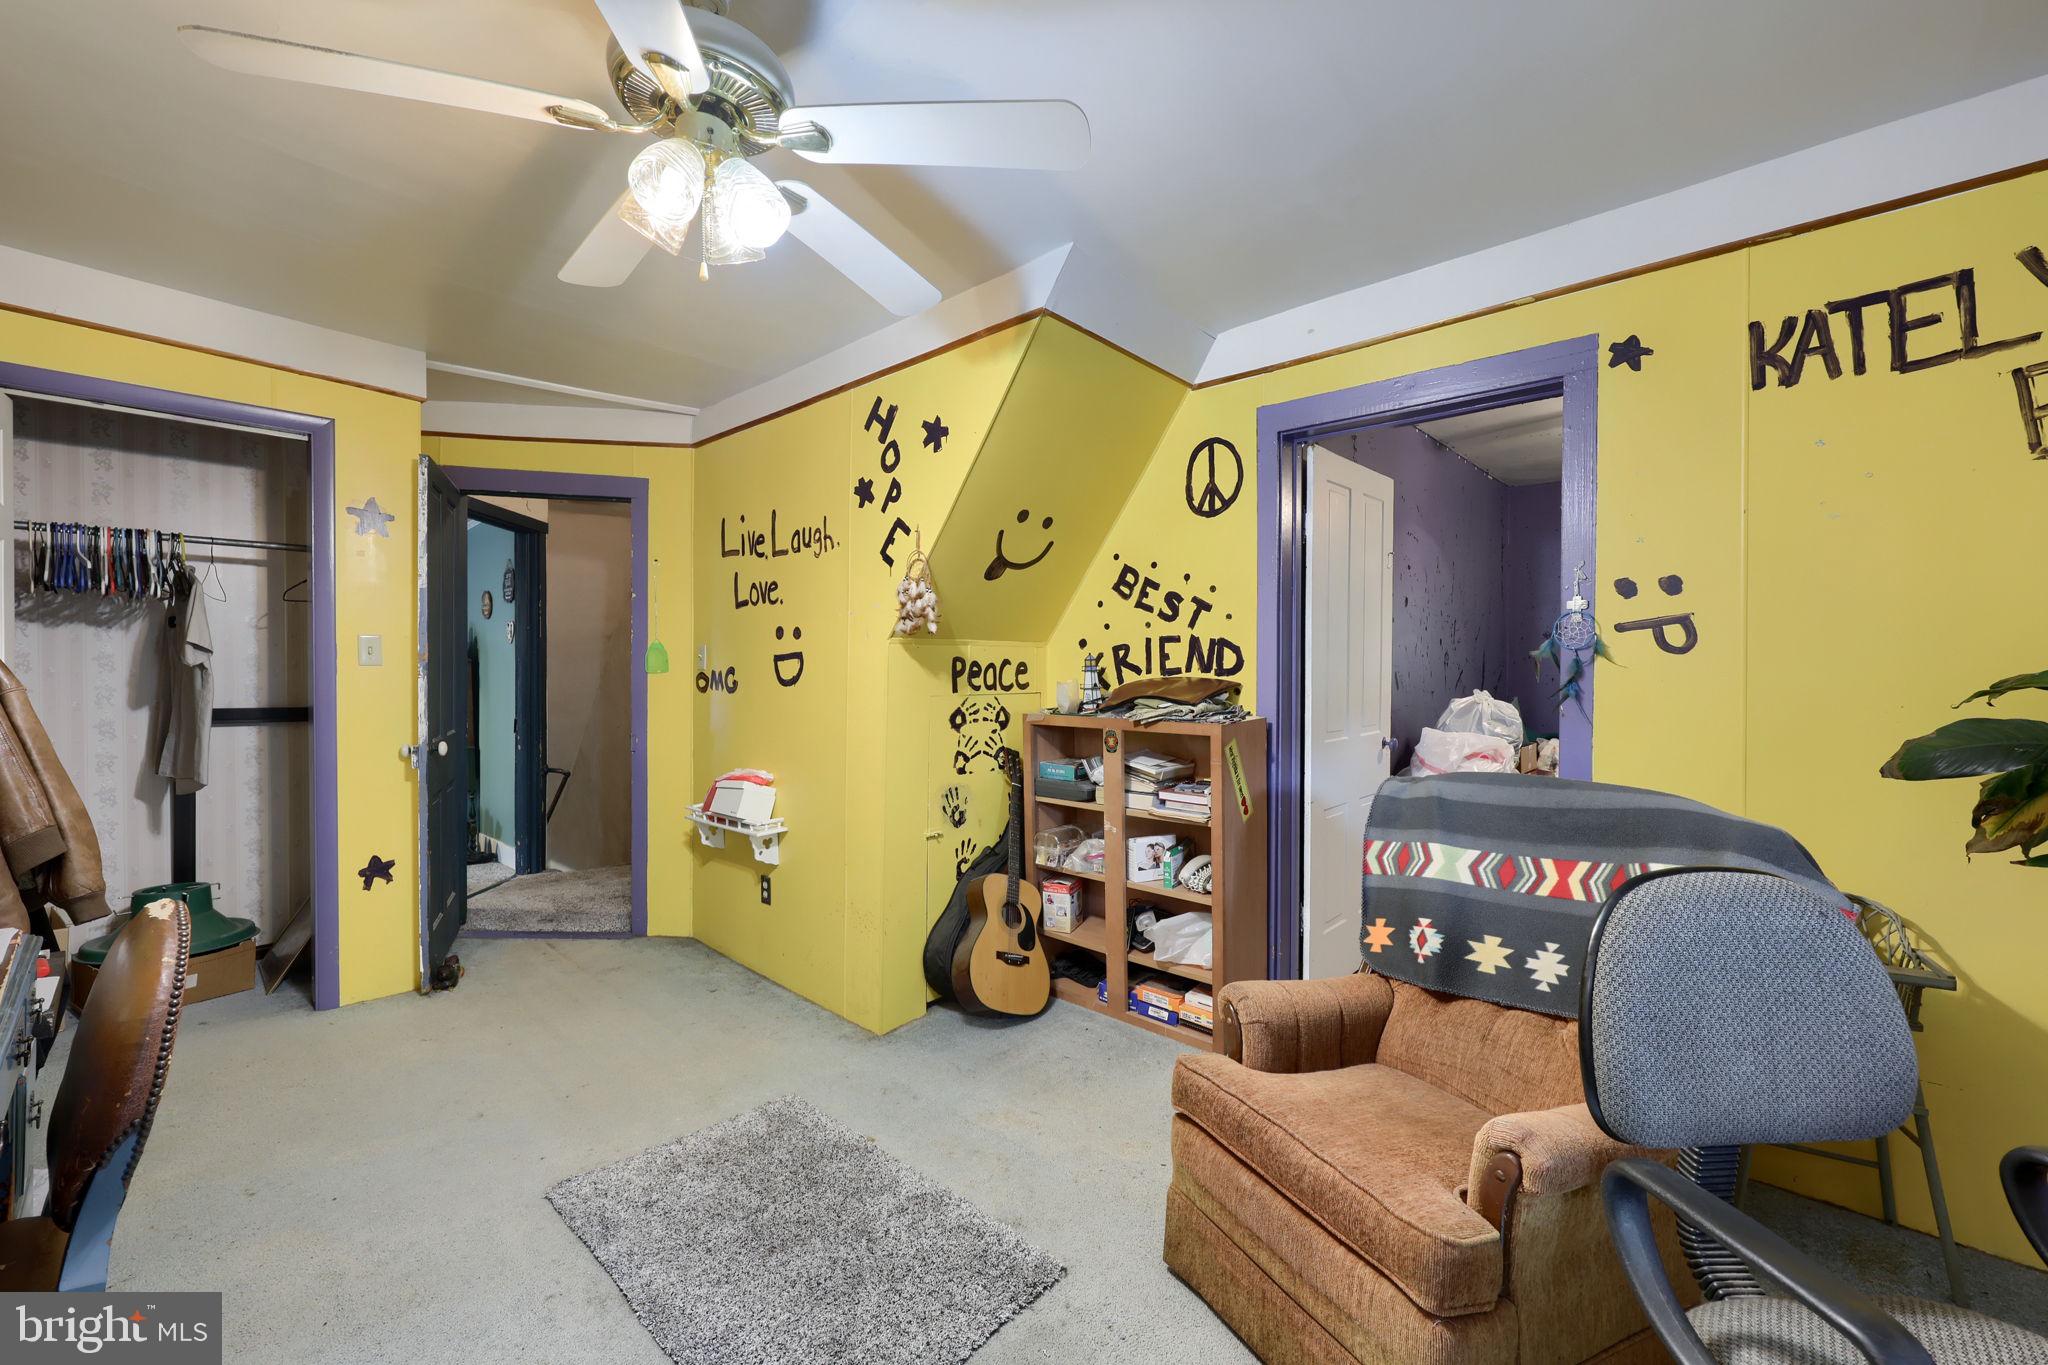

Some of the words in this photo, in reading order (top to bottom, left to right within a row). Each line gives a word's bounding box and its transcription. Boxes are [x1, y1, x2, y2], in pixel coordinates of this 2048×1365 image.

[864, 396, 912, 568] HOPE
[733, 571, 784, 609] Love.
[1111, 563, 1213, 630] BEST
